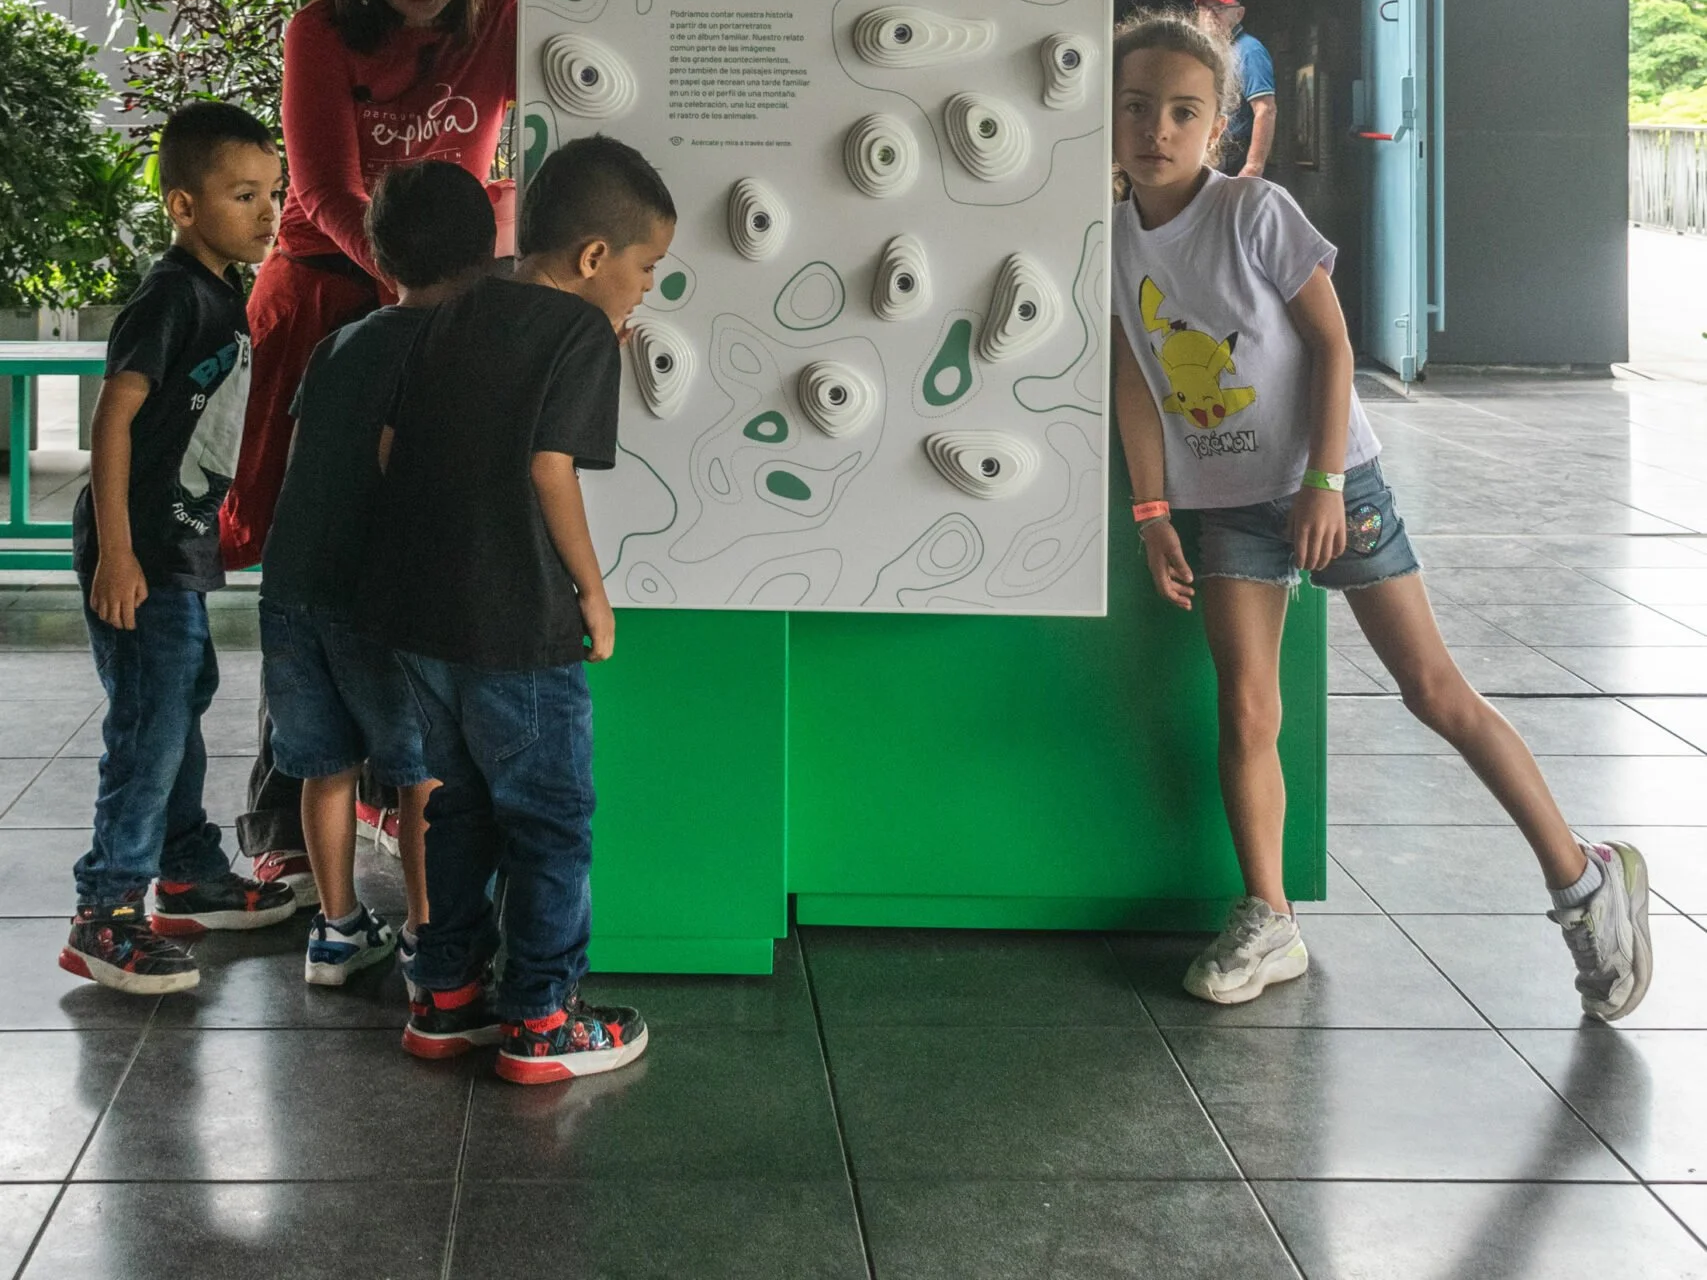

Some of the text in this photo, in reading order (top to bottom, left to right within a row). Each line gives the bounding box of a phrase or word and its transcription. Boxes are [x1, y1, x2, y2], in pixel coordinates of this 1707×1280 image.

[670, 10, 709, 18] Podríamos
[676, 22, 696, 30] partir
[719, 23, 771, 31] portarretratos
[697, 33, 720, 41] álbum
[740, 45, 775, 53] imágenes
[692, 56, 722, 64] grandes
[742, 67, 772, 76] paisajes
[773, 68, 807, 76] impresos
[708, 89, 715, 97] el
[716, 90, 736, 98] perfil
[371, 87, 478, 155] explora
